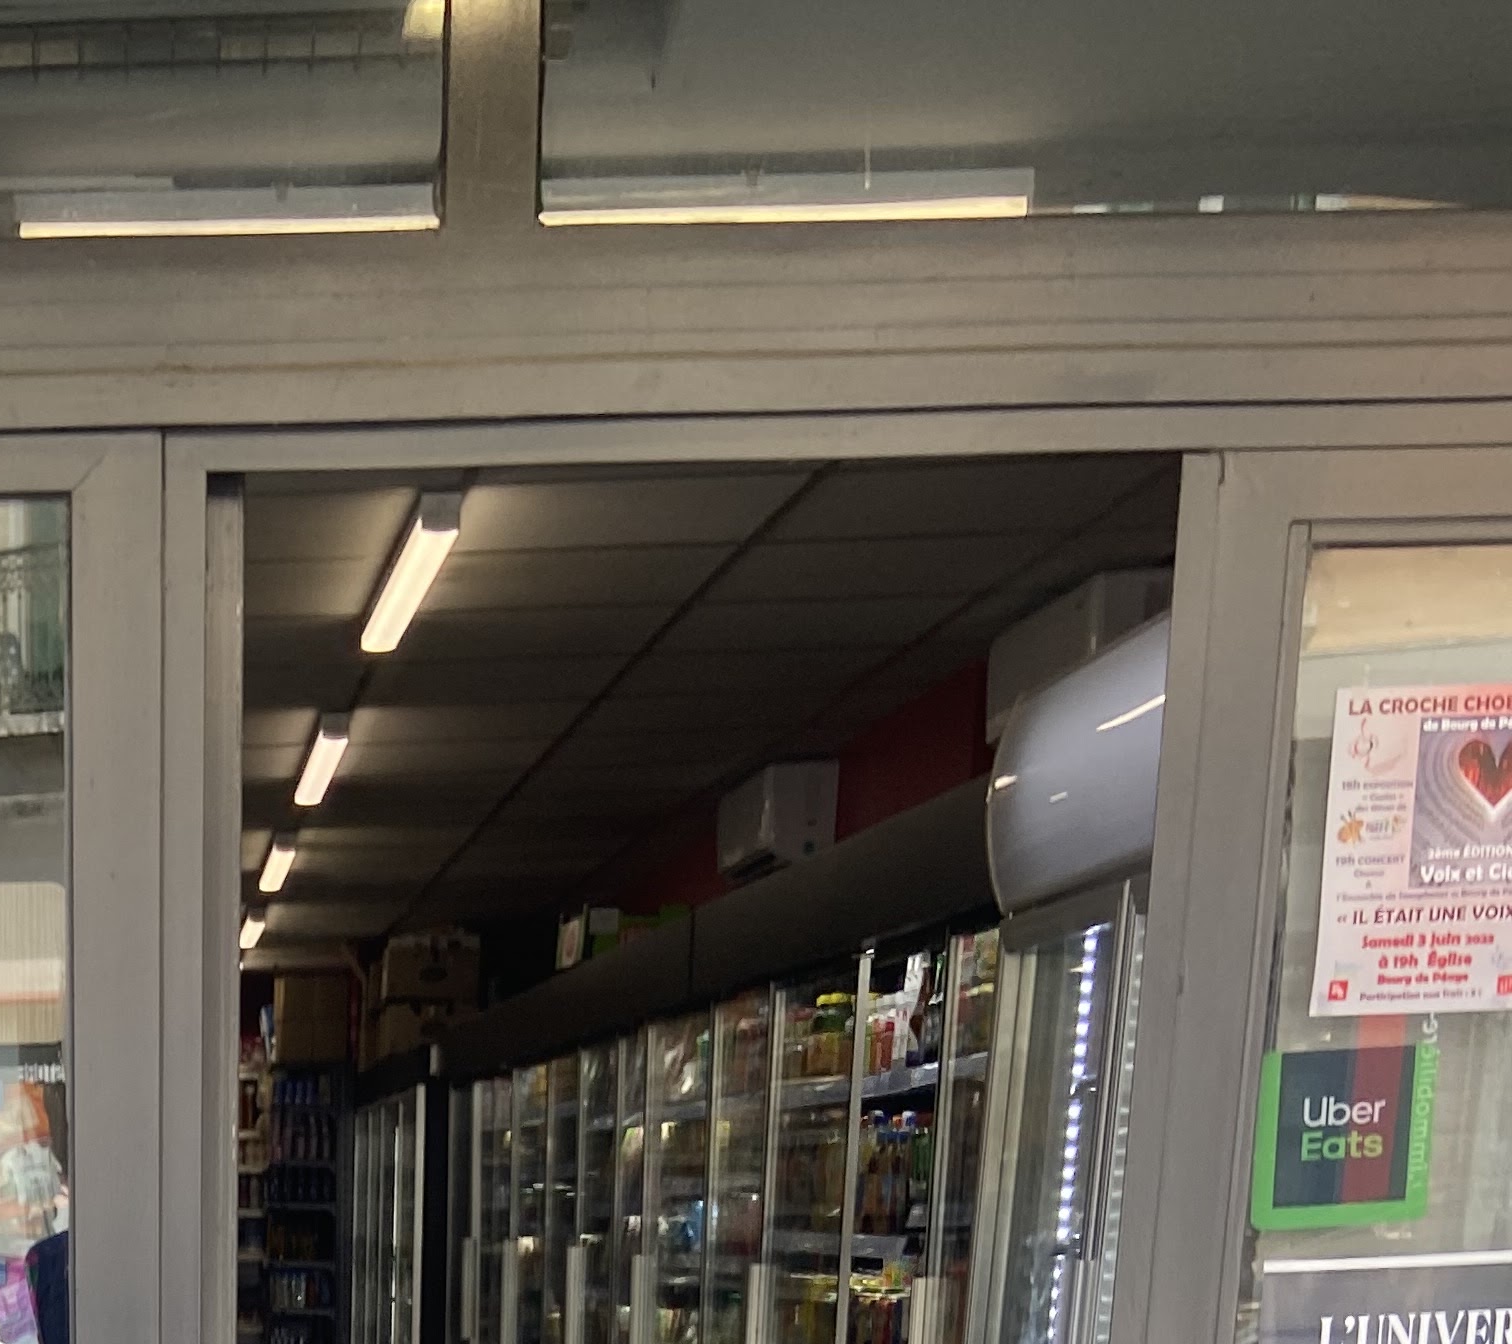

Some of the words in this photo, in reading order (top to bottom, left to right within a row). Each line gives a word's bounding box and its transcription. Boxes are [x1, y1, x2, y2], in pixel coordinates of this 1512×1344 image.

[1349, 698, 1373, 716] LA
[1379, 695, 1458, 715] CROCHE
[1421, 865, 1461, 884] Voix
[1465, 865, 1483, 881] et
[1353, 910, 1368, 925] IL
[1374, 904, 1424, 924] ÉTAIT
[1429, 906, 1467, 922] UNE
[1362, 934, 1414, 949] Samedi
[1394, 953, 1419, 968] 19h
[1427, 950, 1472, 968] Église
[1302, 1096, 1386, 1127] Uber
[1301, 1130, 1383, 1162] Eats
